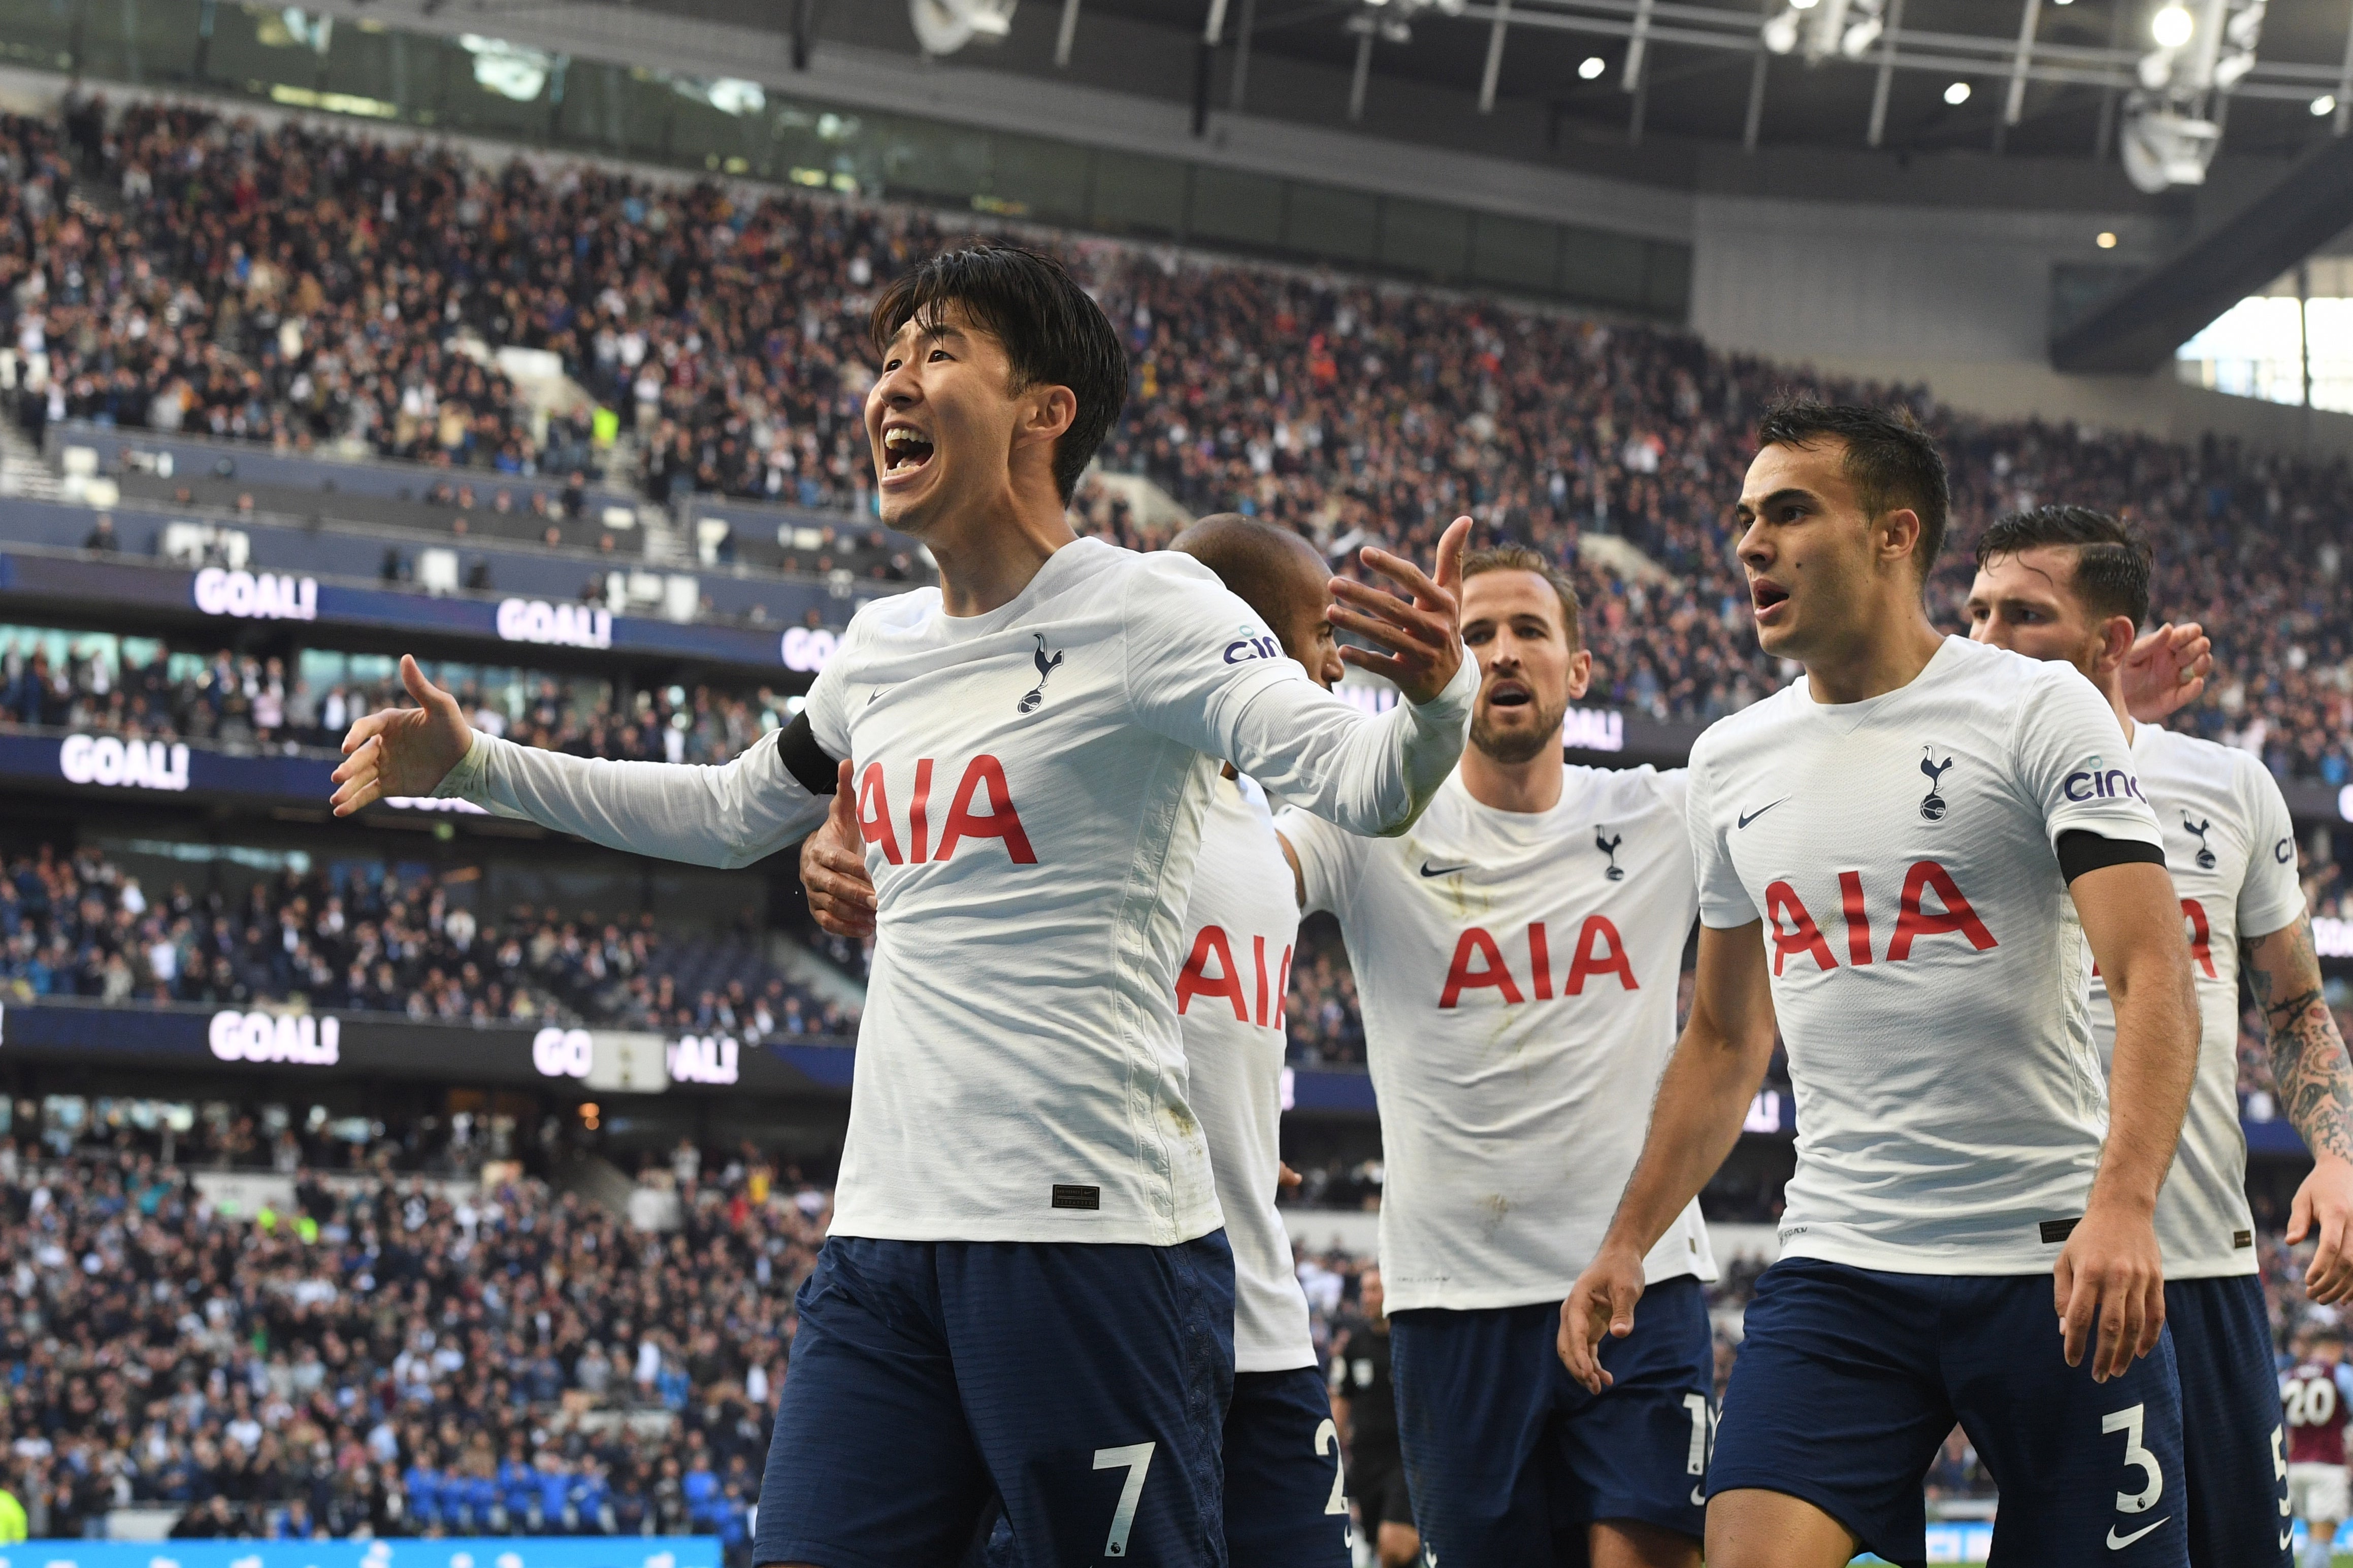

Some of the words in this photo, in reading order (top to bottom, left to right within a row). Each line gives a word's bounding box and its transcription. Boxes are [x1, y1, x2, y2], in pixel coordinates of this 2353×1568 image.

[194, 567, 317, 620] GOAL!
[497, 597, 612, 650] GOAL!
[781, 626, 847, 674] GO
[60, 734, 189, 791] GOAL!
[856, 754, 1038, 864] AIA
[1765, 860, 1999, 977] AIA
[1439, 915, 1639, 1009] AIA
[209, 1010, 340, 1065] GOAL!
[1682, 1392, 1716, 1476] 1
[2281, 1376, 2337, 1428] 20
[2102, 1402, 2163, 1514] 3
[1092, 1441, 1156, 1557] 7
